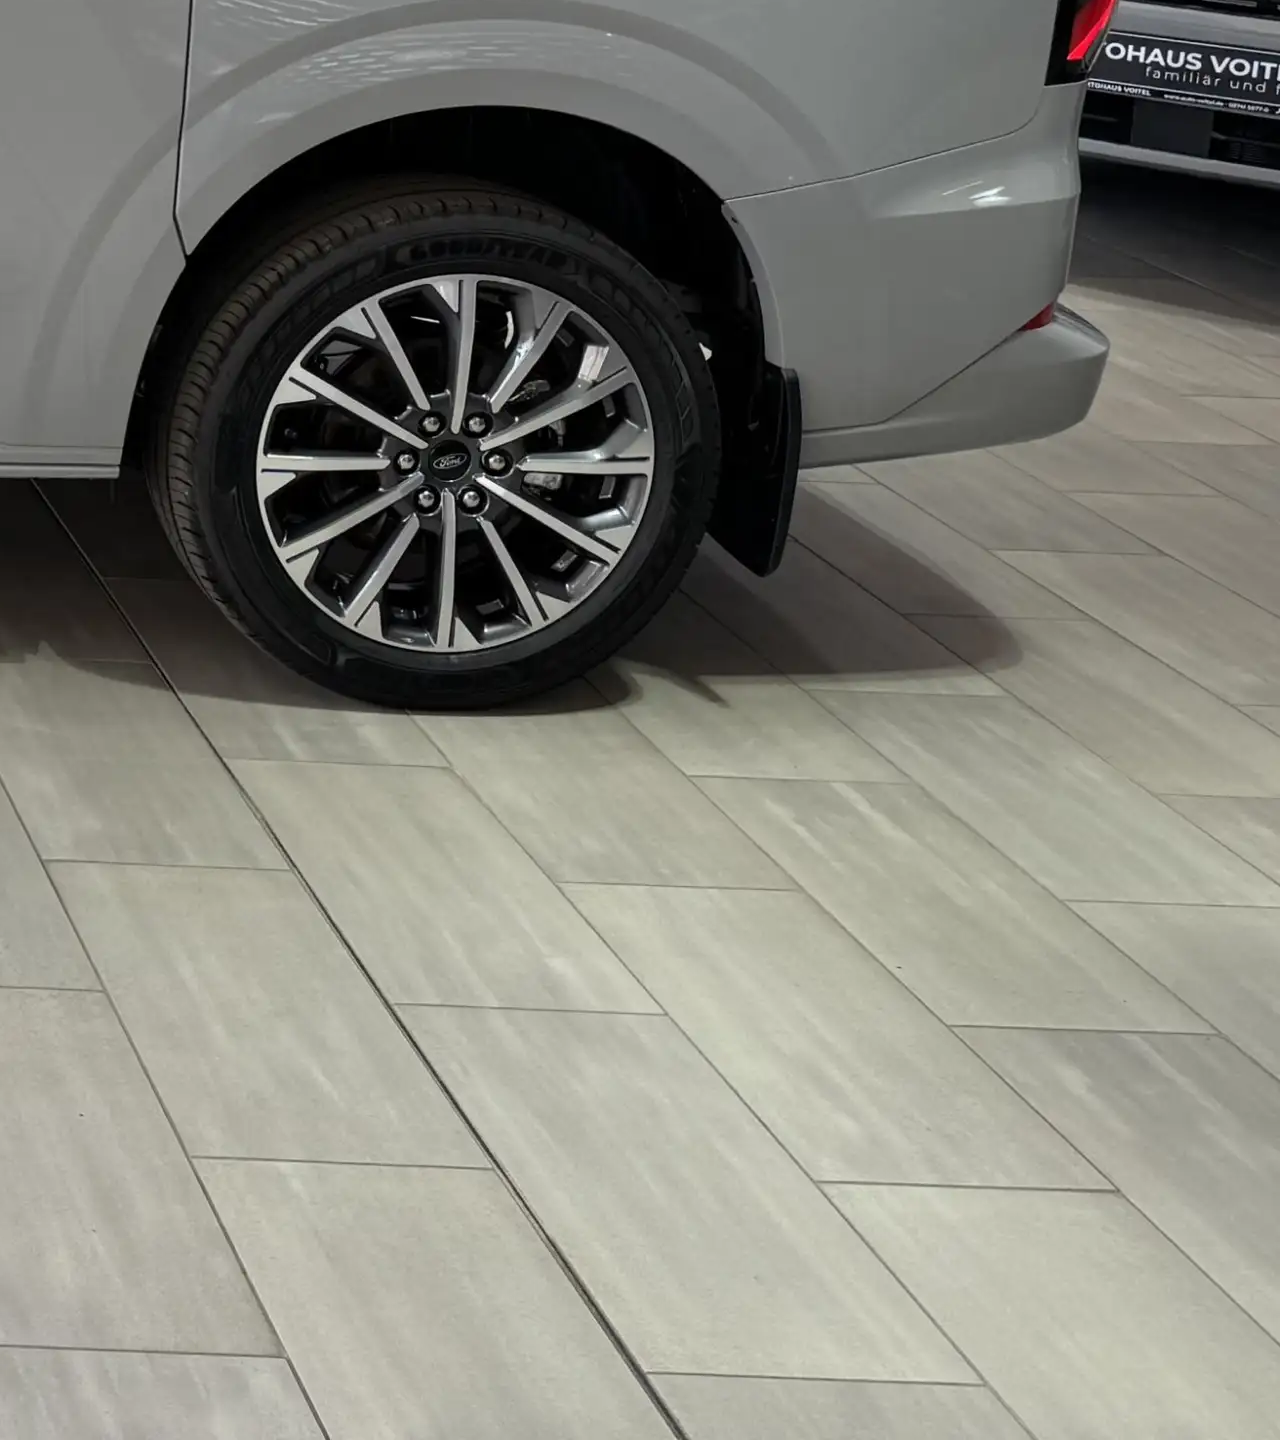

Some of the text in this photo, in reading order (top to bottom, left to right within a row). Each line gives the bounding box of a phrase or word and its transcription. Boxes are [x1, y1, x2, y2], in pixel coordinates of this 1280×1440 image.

[1103, 41, 1202, 71] OHAUS
[1144, 65, 1222, 87] familiär
[1229, 79, 1267, 93] und
